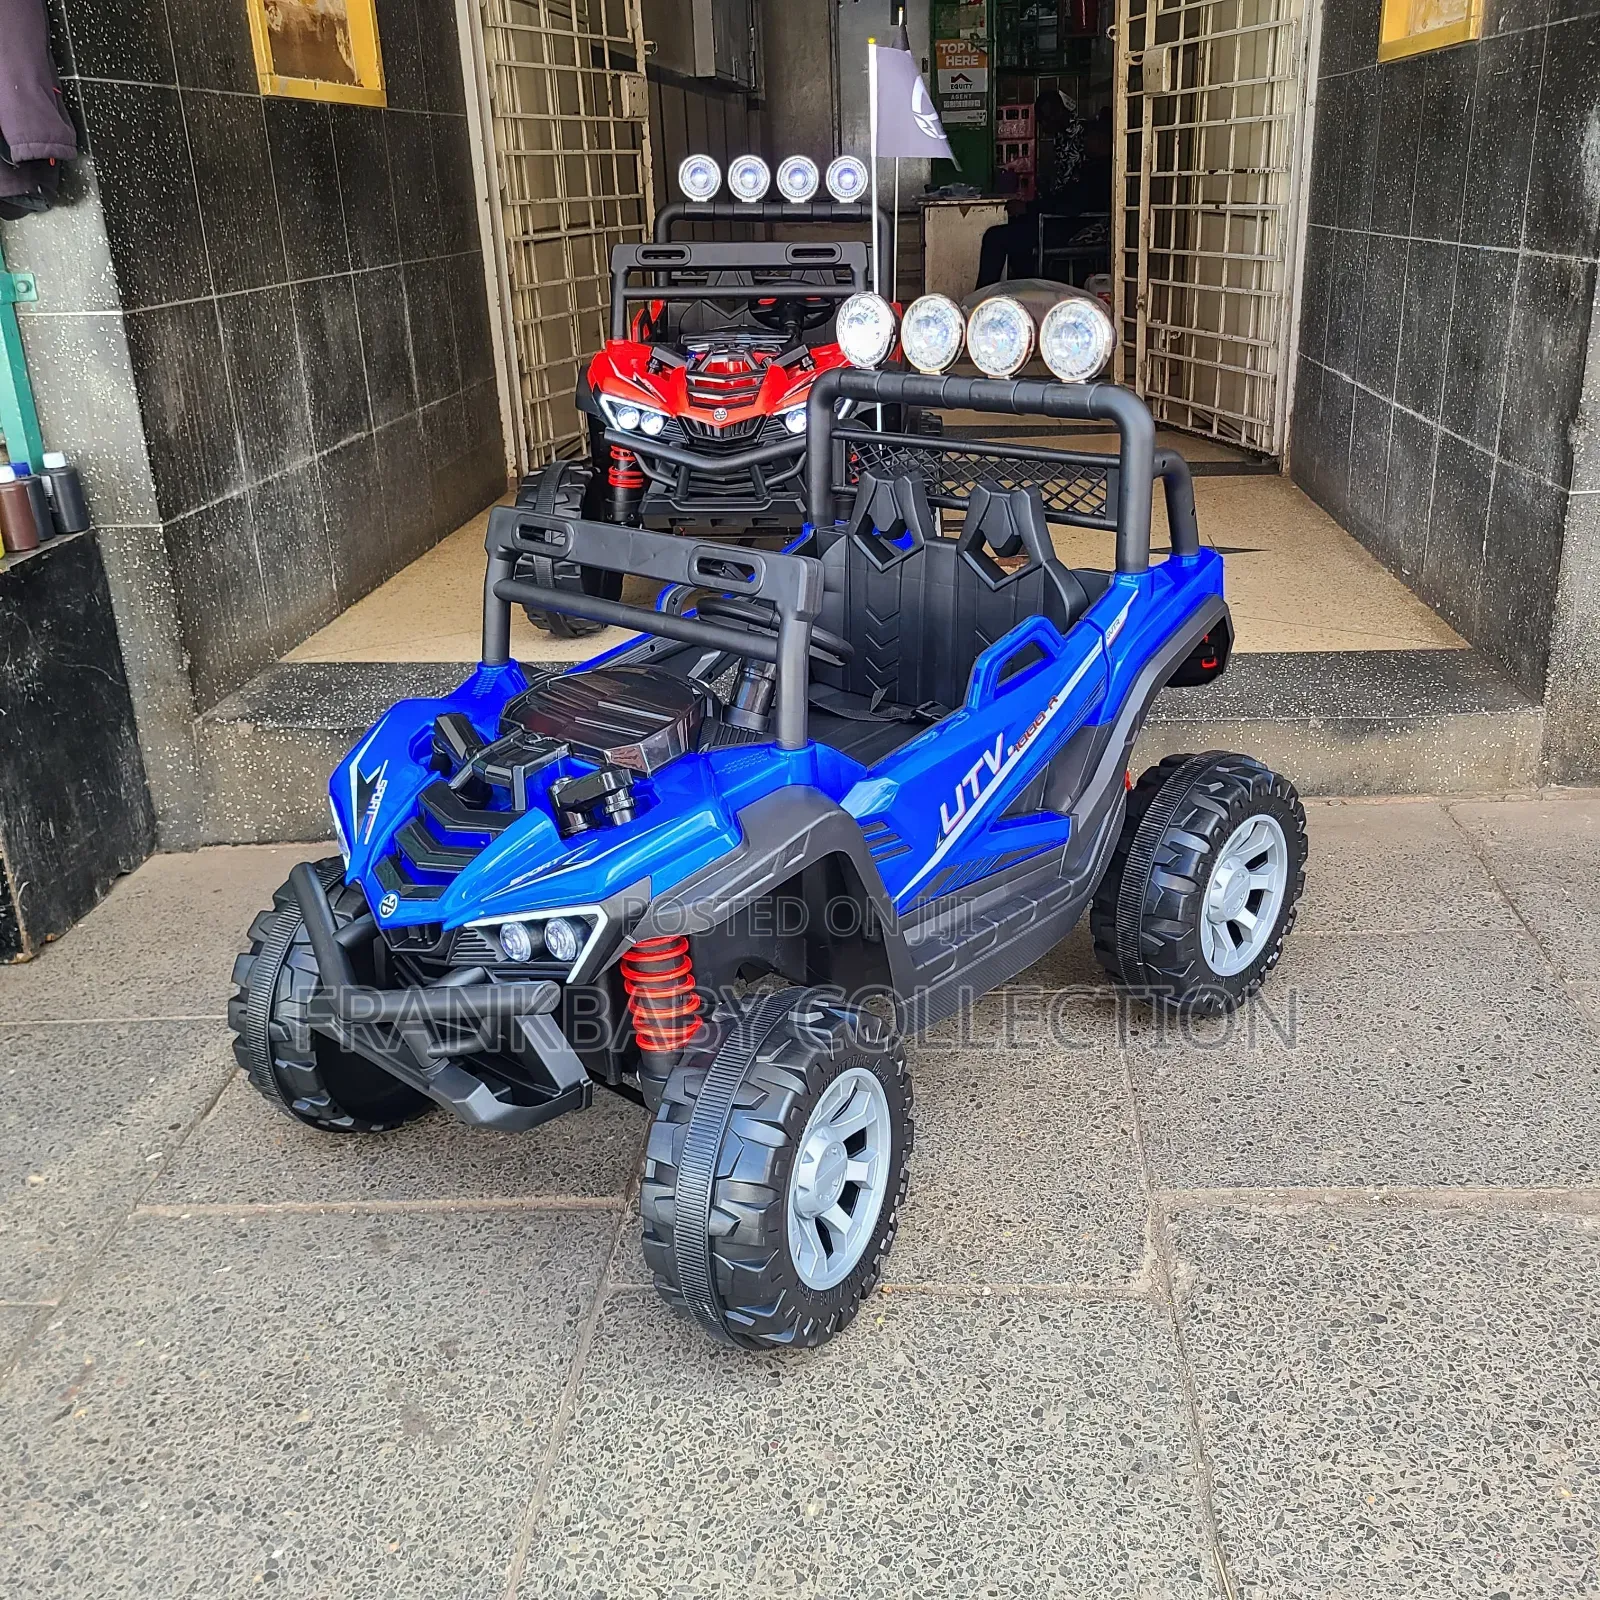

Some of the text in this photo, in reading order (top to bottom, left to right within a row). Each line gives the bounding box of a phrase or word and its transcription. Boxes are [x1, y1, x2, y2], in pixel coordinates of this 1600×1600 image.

[940, 43, 965, 54] TOP
[945, 55, 979, 66] HERE
[1048, 694, 1059, 710] R
